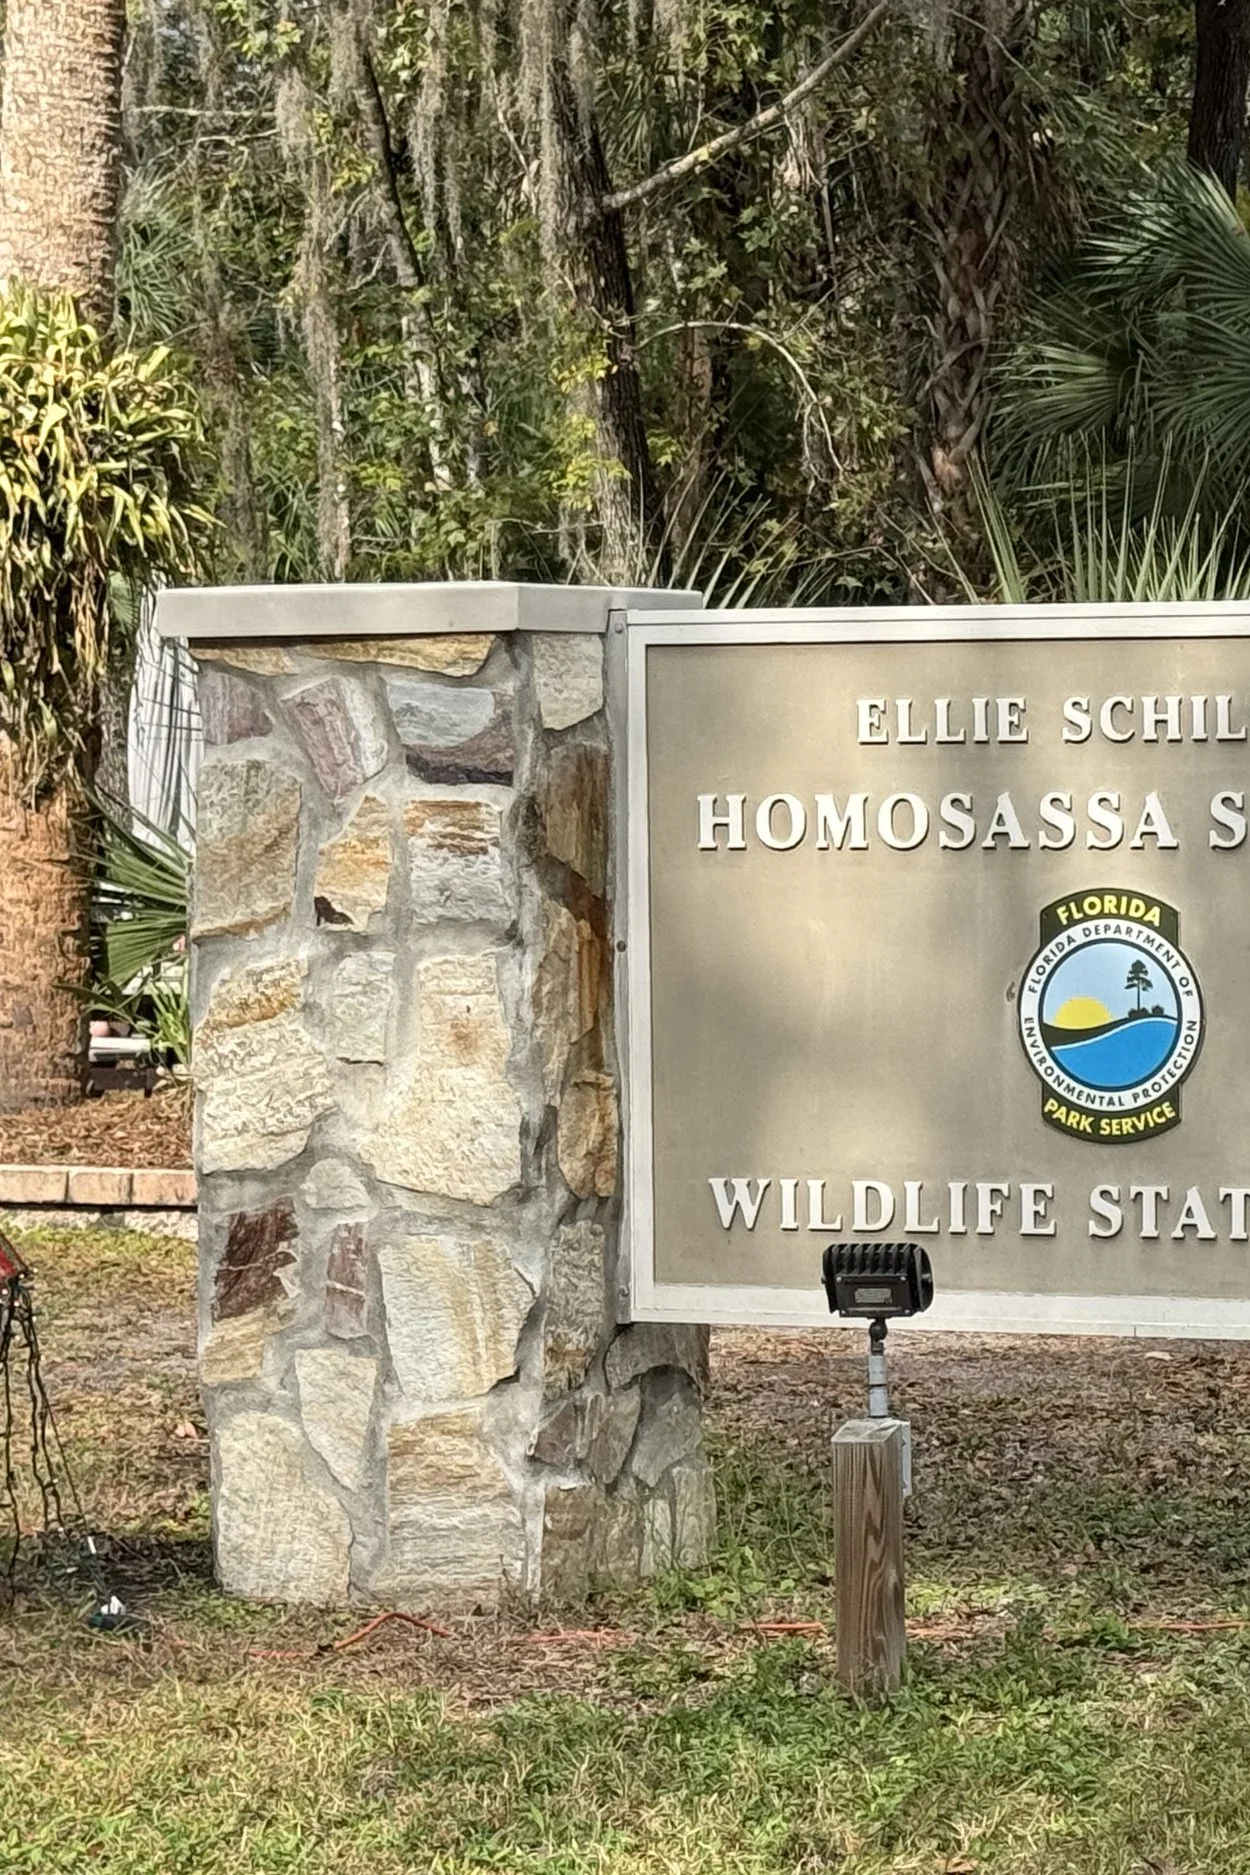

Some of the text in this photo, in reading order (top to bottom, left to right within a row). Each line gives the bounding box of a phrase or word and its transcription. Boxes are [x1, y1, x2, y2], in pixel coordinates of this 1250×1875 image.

[856, 696, 1030, 745] ELLIE
[697, 791, 1179, 852] HOMOSASSA
[1056, 895, 1163, 927] FLORIDA
[1028, 924, 1194, 998] FLORIDA DEPARTMENT OF
[1024, 1017, 1197, 1107] ENVIRONMENTAL PROTECTION
[1043, 1098, 1176, 1136] PARK SERVICE
[708, 1177, 1058, 1238] WILDLIFE
